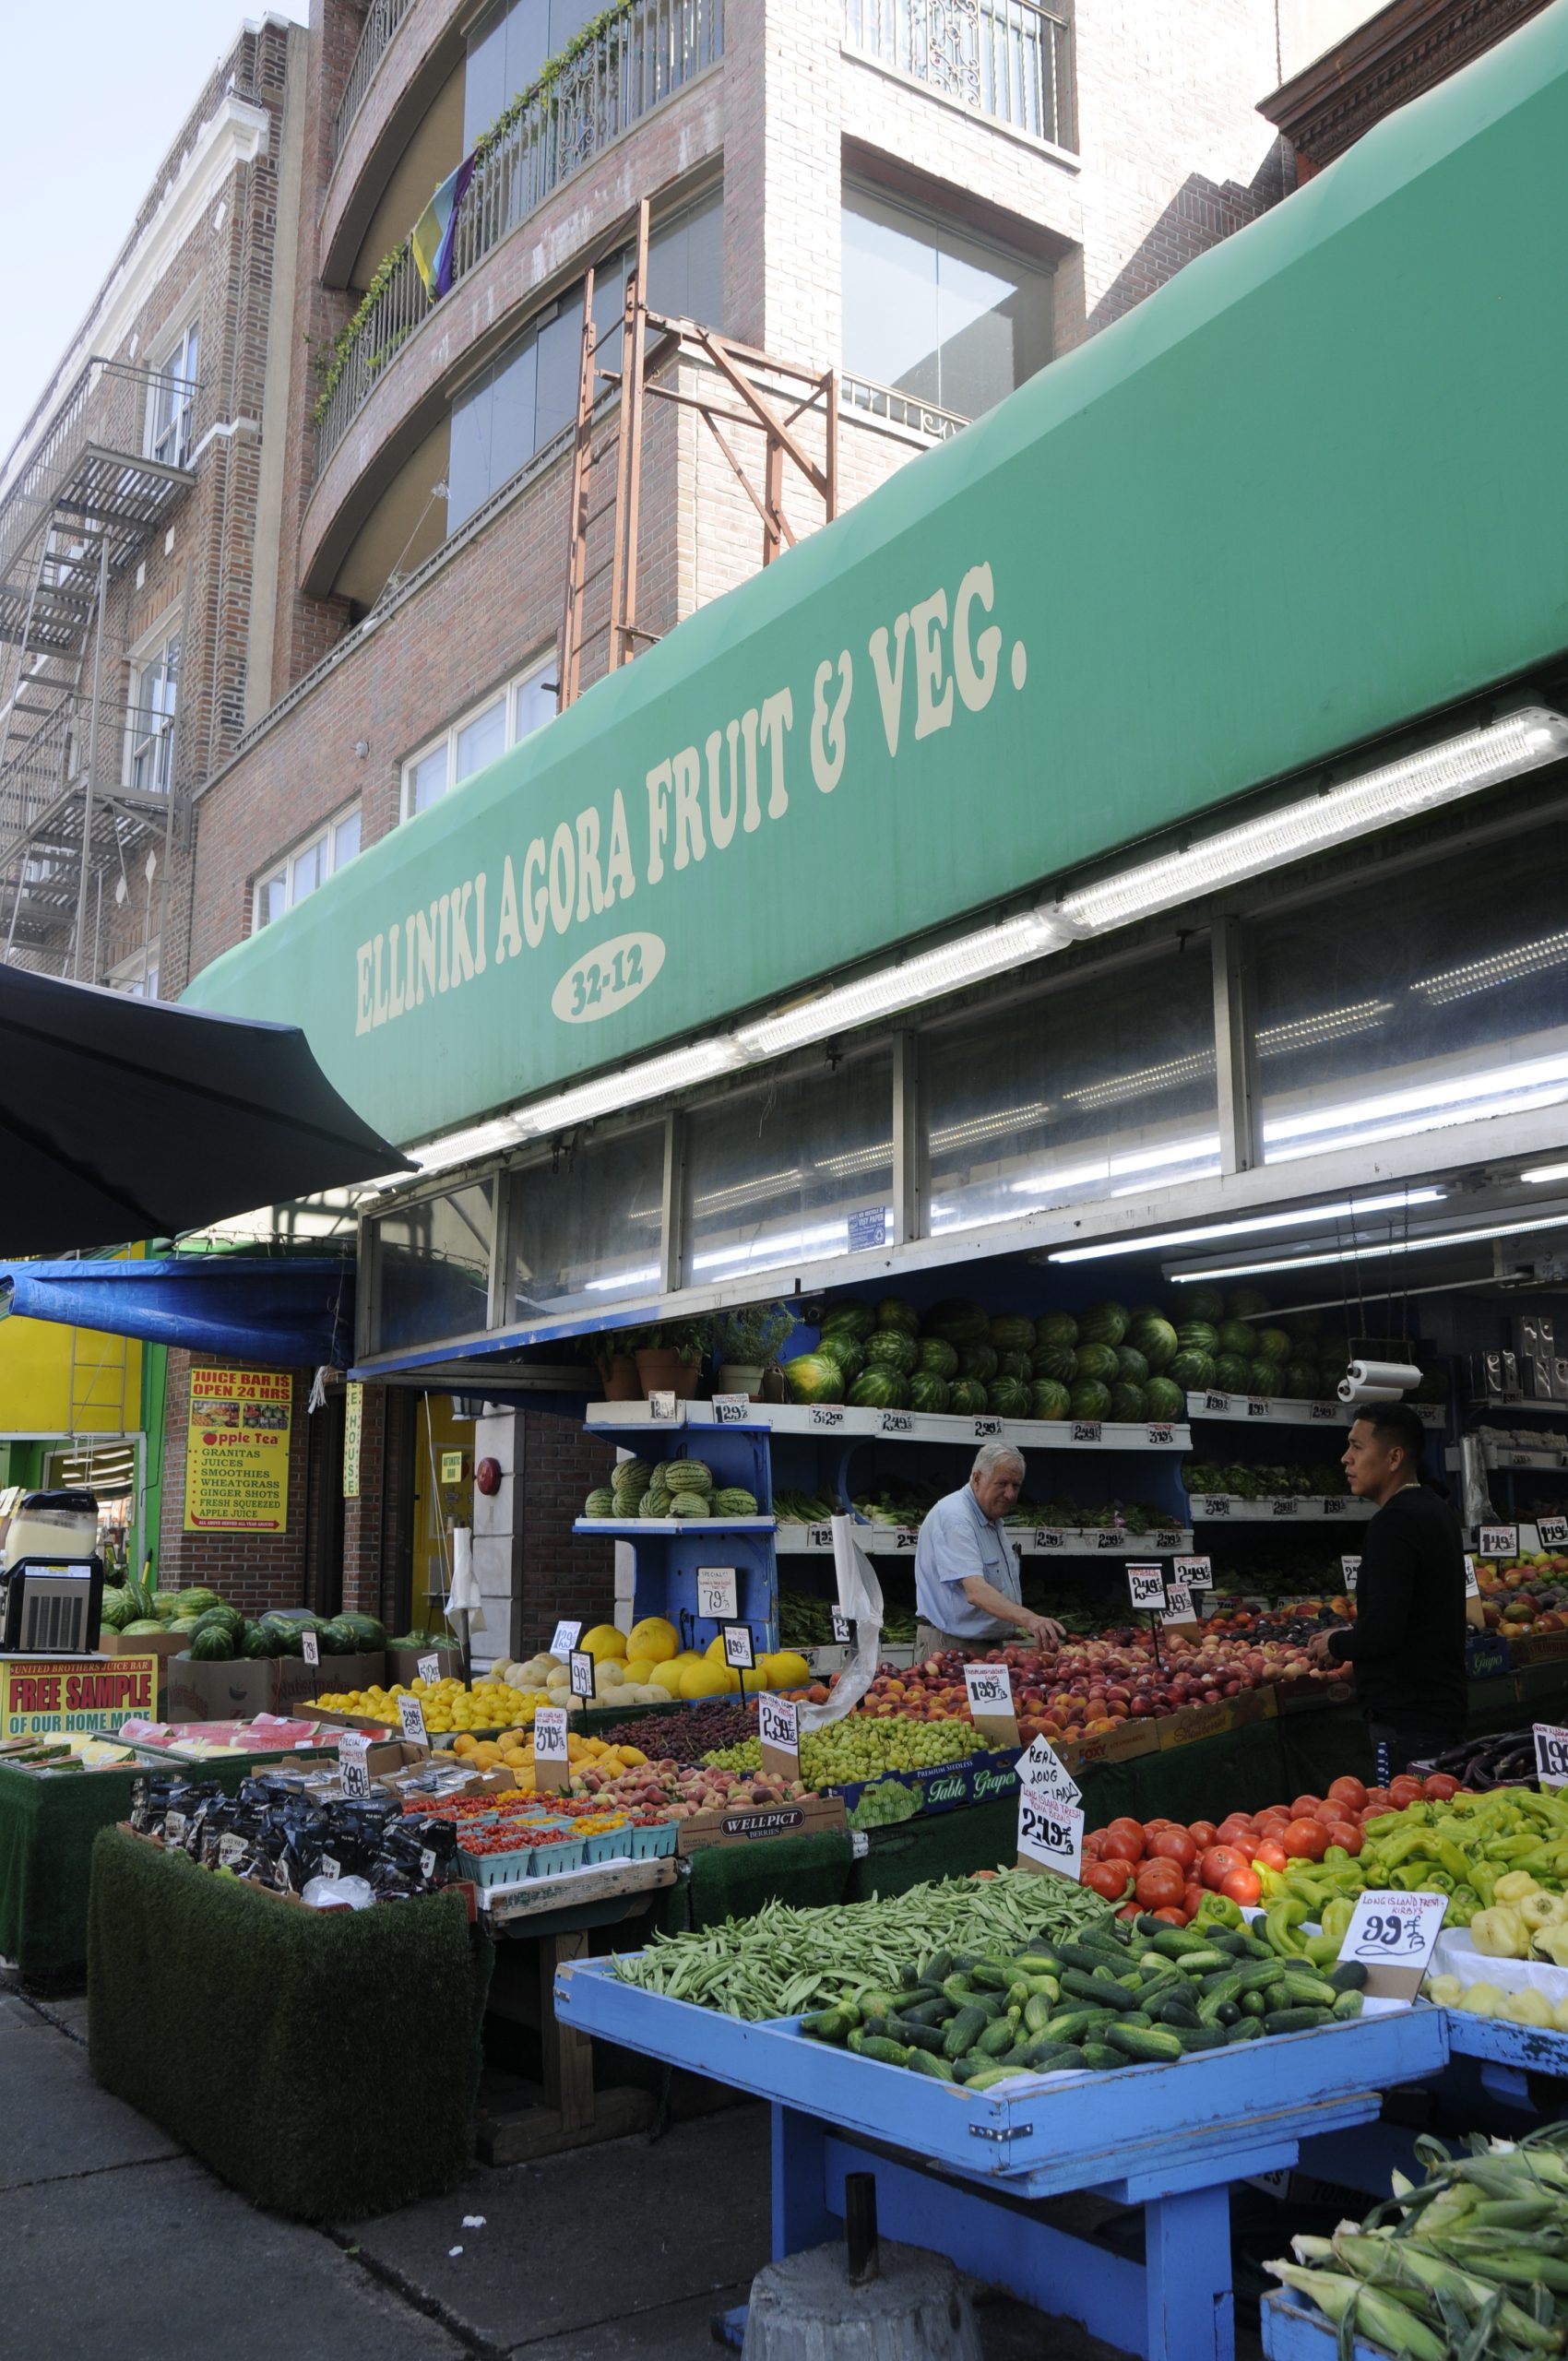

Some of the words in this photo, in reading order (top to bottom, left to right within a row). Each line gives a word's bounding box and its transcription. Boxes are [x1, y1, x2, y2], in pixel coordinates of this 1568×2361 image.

[356, 872, 486, 1036] ELLINIKI
[495, 789, 636, 966] AGORA
[647, 687, 793, 885] FRUIT
[811, 649, 852, 793] &
[869, 561, 1028, 757] VEG.
[570, 943, 644, 1013] 32-12
[194, 1370, 236, 1383] JUICE
[241, 1374, 271, 1385] BAR
[193, 1383, 232, 1396] OPEN
[237, 1386, 255, 1398] 24
[260, 1387, 290, 1400] HRS
[255, 1432, 279, 1444] Tea
[202, 1449, 260, 1458] GRANITAS
[348, 1416, 358, 1493] HOUSE
[201, 1459, 244, 1467] JUICES
[201, 1468, 270, 1478] SMOOTHIES
[201, 1478, 279, 1489] WHEATGRASS
[200, 1489, 242, 1497] GINGER
[244, 1490, 279, 1499] SHOTS
[233, 1500, 280, 1509] SQUEEZED
[199, 1509, 228, 1517] APPLE
[231, 1510, 257, 1518] JUICE
[15, 1664, 50, 1675] UNITED
[52, 1663, 100, 1673] BROTHERS
[101, 1661, 128, 1671] JUICE
[130, 1660, 148, 1670] BAR
[9, 1678, 61, 1713] FREE
[65, 1674, 151, 1711] SAMPLE
[9, 1716, 28, 1734] OF
[31, 1714, 61, 1733] OUR
[65, 1713, 106, 1731] HOME
[1029, 1746, 1057, 1765] REAL
[1079, 1743, 1106, 1759] FOXY
[917, 1766, 945, 1778] PREMIUM
[1030, 1770, 1058, 1785] LONG
[928, 1778, 966, 1802] Table
[973, 1769, 1016, 1798] Grapes
[750, 1828, 779, 1838] BERRIES
[1021, 1808, 1063, 1846] 249
[1363, 1896, 1385, 1904] LONG
[1387, 1895, 1417, 1905] ISLAND
